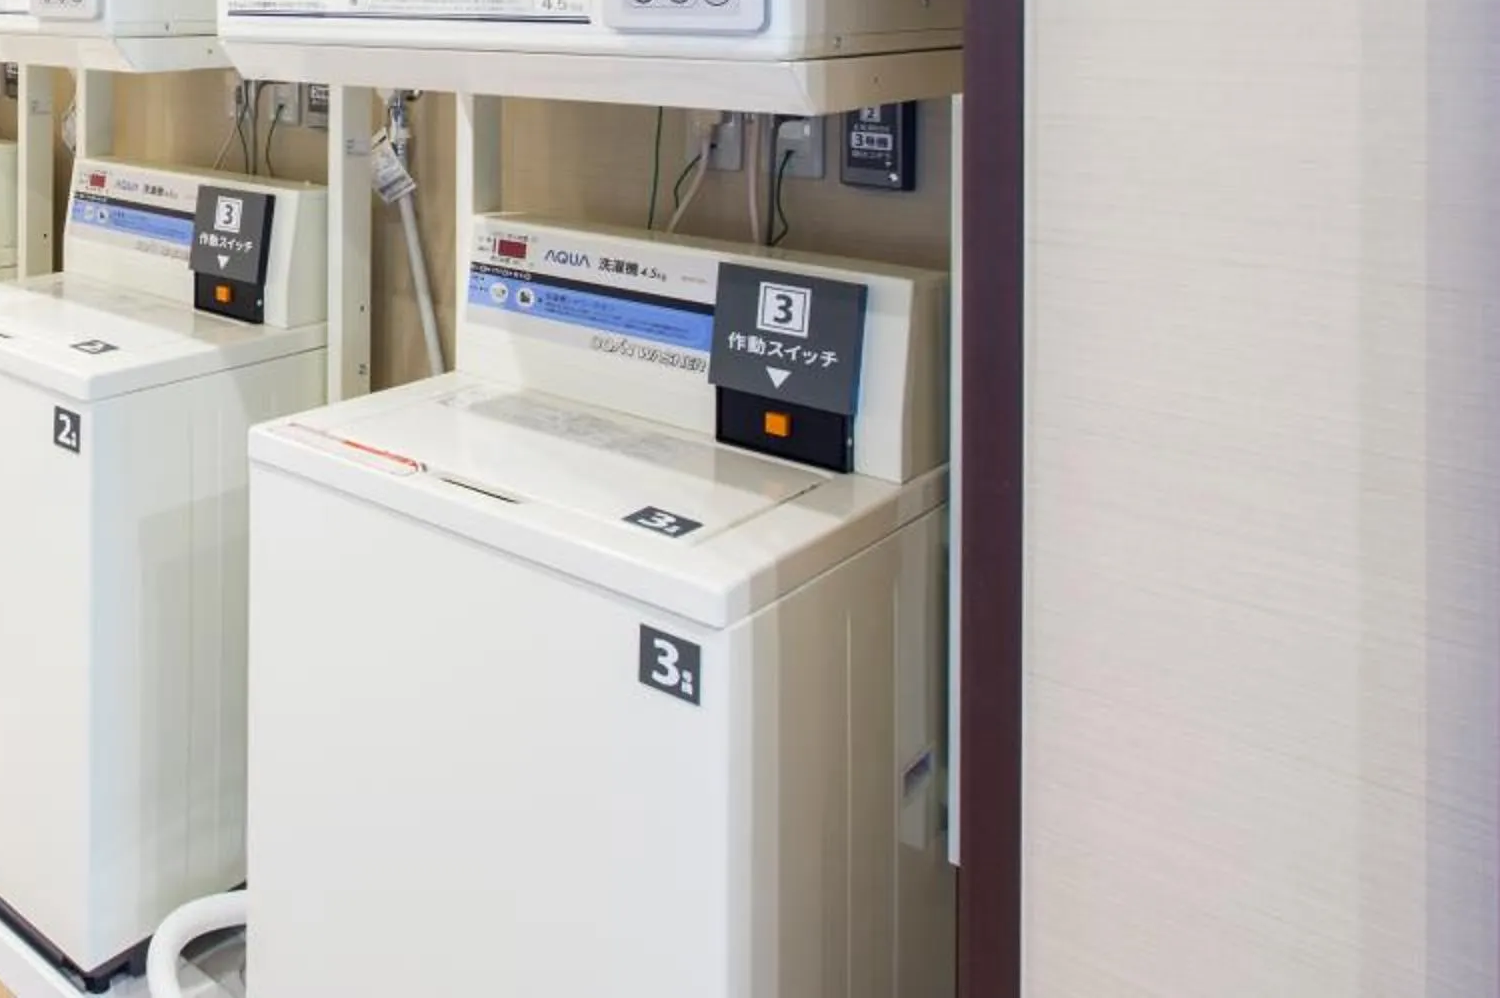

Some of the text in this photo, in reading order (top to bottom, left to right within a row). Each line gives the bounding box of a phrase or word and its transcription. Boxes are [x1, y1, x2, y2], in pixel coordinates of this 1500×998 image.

[222, 203, 233, 225] 3
[544, 249, 590, 269] AQUA
[598, 257, 639, 277] 洗濯機
[772, 292, 795, 326] 3
[728, 332, 838, 369] 作動スイッチ
